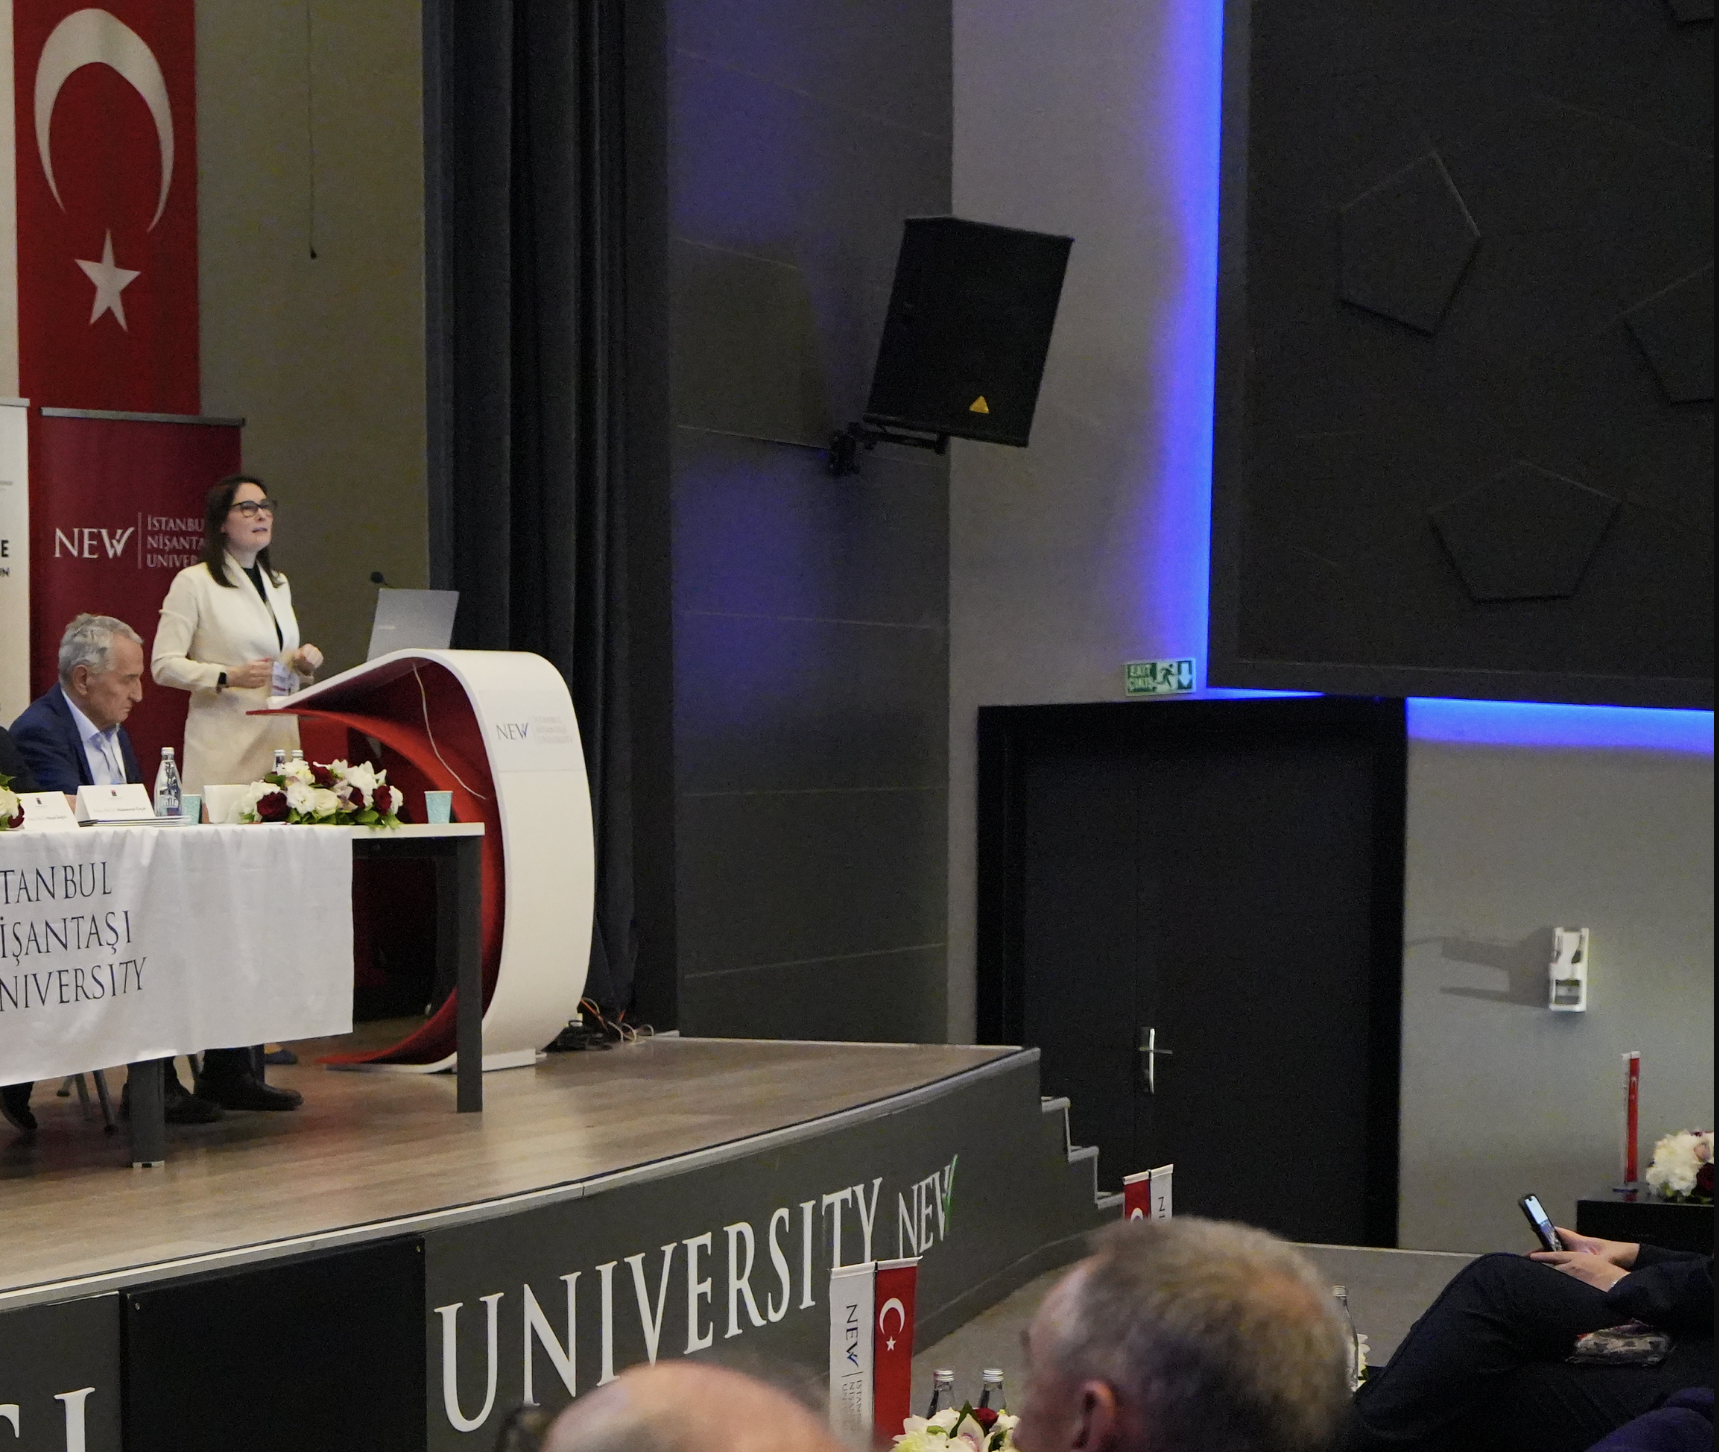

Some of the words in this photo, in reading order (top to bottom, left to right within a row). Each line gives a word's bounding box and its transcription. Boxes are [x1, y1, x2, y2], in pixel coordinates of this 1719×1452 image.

[147, 515, 205, 532] İSTANBU
[54, 527, 135, 559] NEW
[147, 534, 204, 551] NİŞANTA
[146, 554, 198, 568] UNIVER
[496, 722, 529, 741] NEW
[434, 1176, 883, 1433] UNIVERSITY
[898, 1153, 958, 1260] NEW
[845, 1304, 859, 1367] NEW
